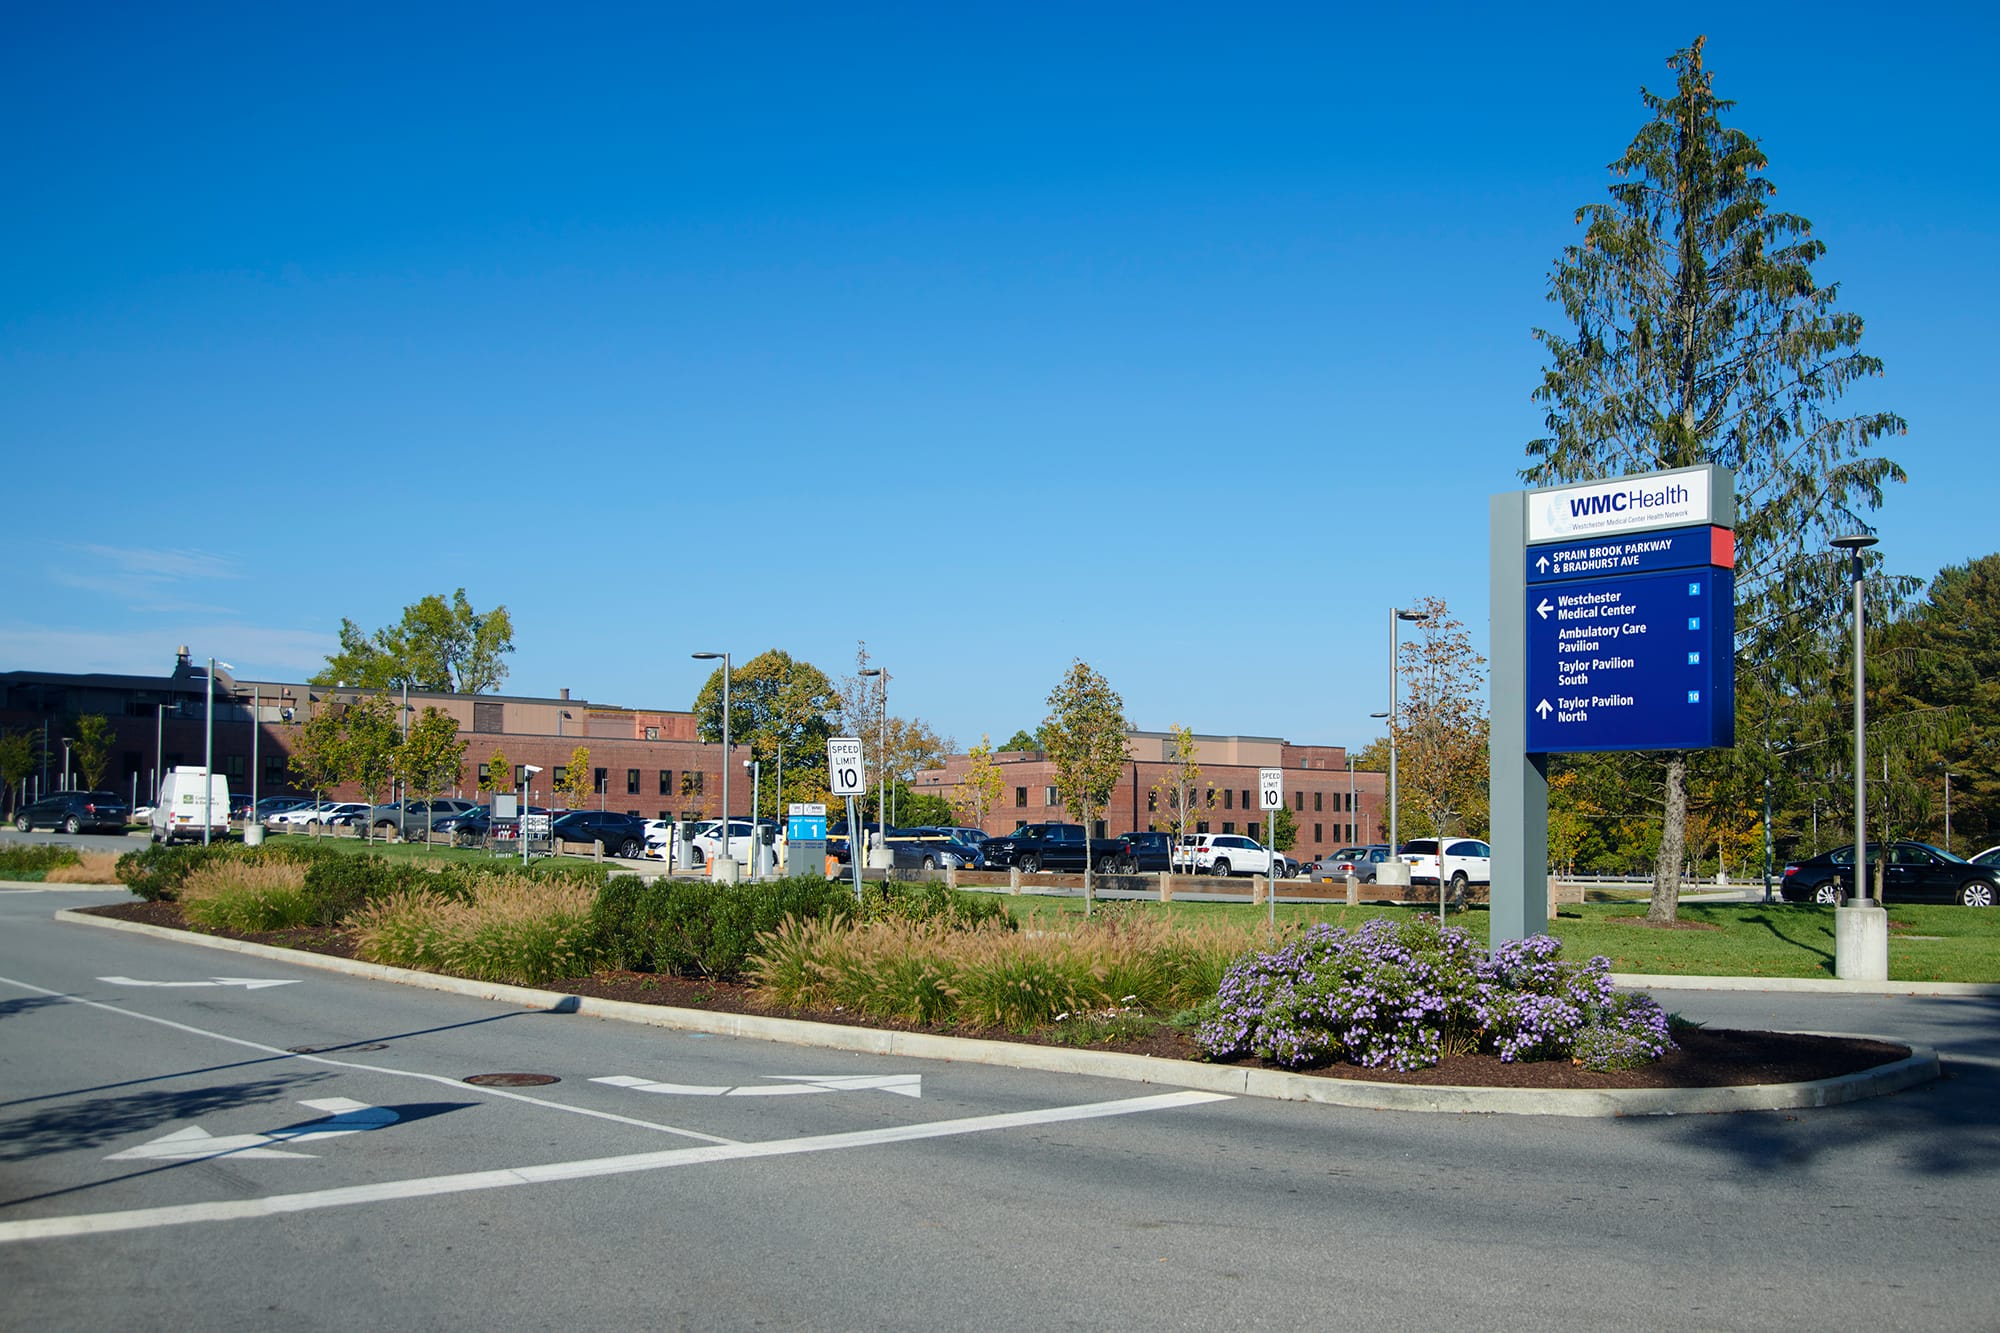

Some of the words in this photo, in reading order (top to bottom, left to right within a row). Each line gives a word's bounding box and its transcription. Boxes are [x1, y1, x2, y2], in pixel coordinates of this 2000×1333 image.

[1570, 484, 1688, 517] WMCHealth
[1572, 520, 1605, 530] Westchester
[1606, 517, 1627, 526] Medical
[1628, 516, 1645, 524] Center
[1647, 513, 1664, 521] Health
[1665, 510, 1688, 519] Network
[1553, 549, 1587, 562] SPRAIN
[1590, 545, 1622, 558] BROOK
[1625, 539, 1672, 554] PARKWAY
[1553, 563, 1560, 573] &
[1563, 557, 1619, 573] BRADHURST
[1620, 555, 1640, 567] AVE
[1692, 585, 1697, 593] 2
[1558, 592, 1621, 607] Westchester
[1558, 606, 1598, 620] Medical
[1600, 604, 1636, 617] Center
[1558, 625, 1620, 639] Ambulatory
[1622, 623, 1647, 635] Care
[1692, 620, 1697, 628] 1
[1558, 640, 1599, 653] Pavilion
[1558, 659, 1590, 674] Taylor
[1592, 657, 1634, 670] Pavilion
[1689, 654, 1699, 662] 10
[1558, 673, 1588, 686] South
[1558, 696, 1589, 711] Taylor
[1592, 694, 1634, 707] Pavilion
[1689, 692, 1699, 701] 10
[1558, 710, 1587, 722] North
[832, 745, 859, 754] SPEED
[836, 757, 857, 766] LIMIT
[838, 768, 857, 788] 10
[1261, 772, 1280, 780] SPEED
[1264, 790, 1278, 805] 10
[793, 823, 798, 838] 1
[811, 823, 818, 838] 1
